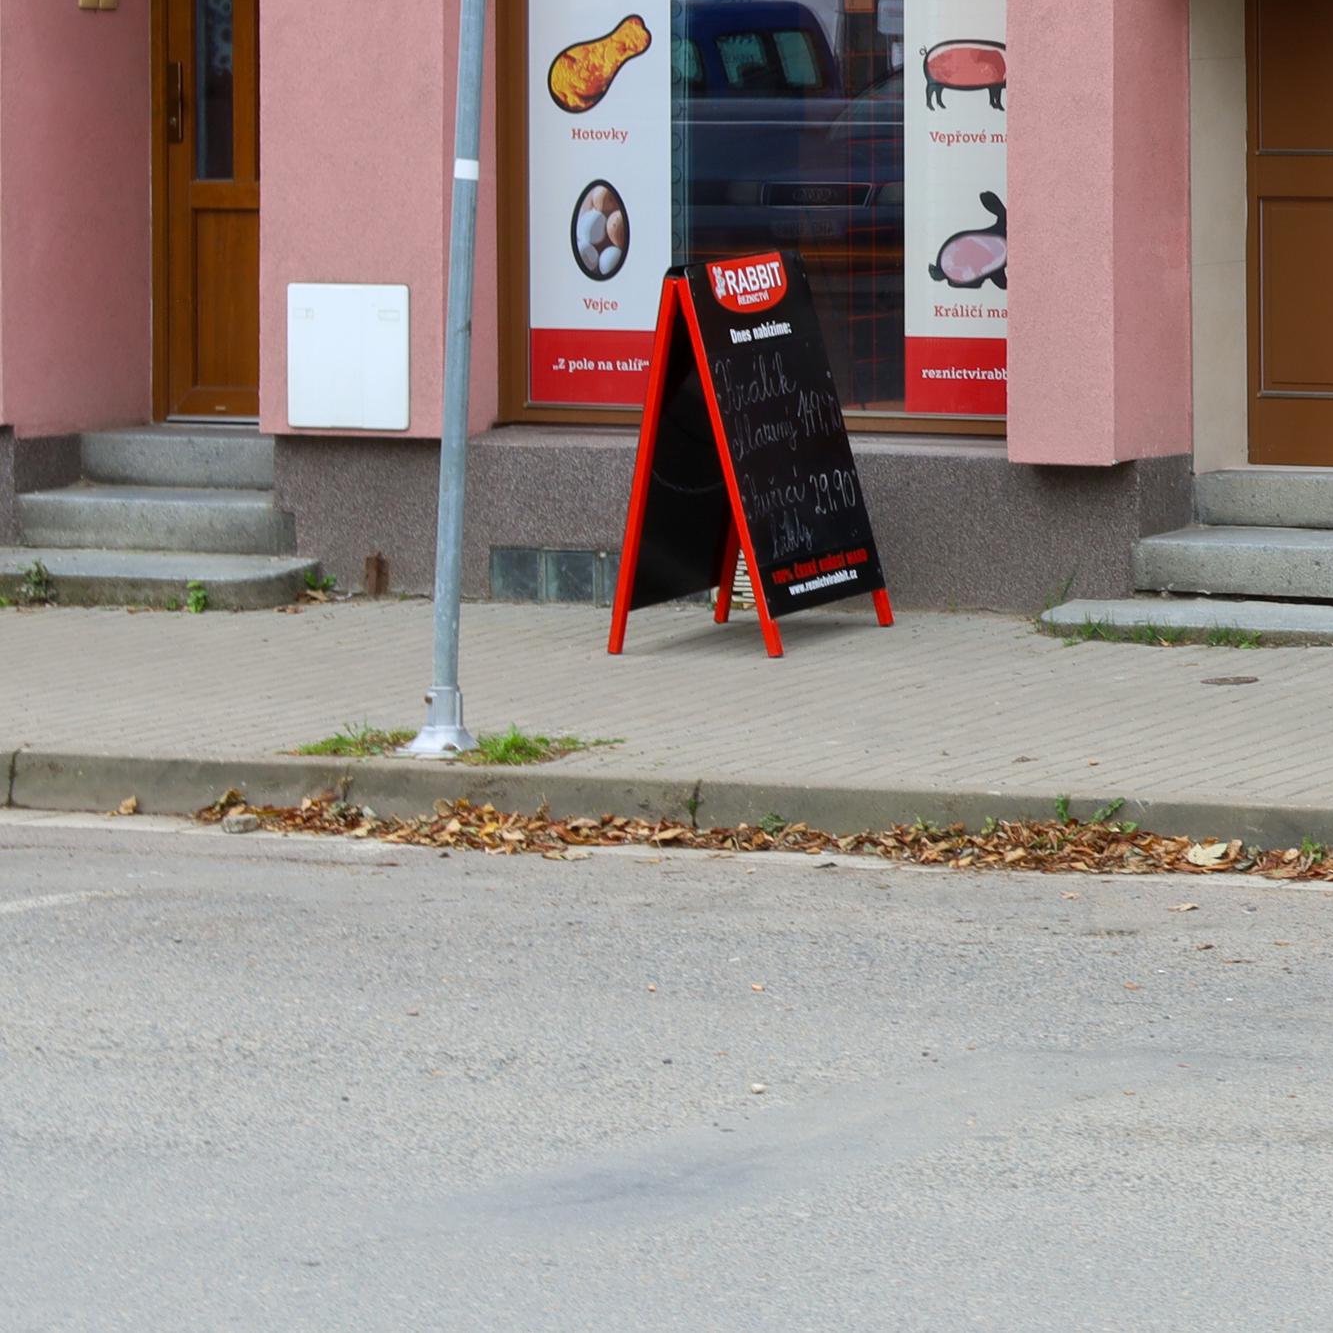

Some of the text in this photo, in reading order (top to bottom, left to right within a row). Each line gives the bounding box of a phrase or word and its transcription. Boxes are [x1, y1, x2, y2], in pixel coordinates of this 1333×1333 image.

[571, 128, 629, 144] Hotovky
[929, 130, 987, 146] Vepřové
[724, 261, 782, 296] RABBIT
[583, 298, 618, 314] Vejce
[934, 305, 983, 318] Králičí
[729, 320, 792, 344] Dnes nabízíme:
[568, 358, 594, 373] pole
[598, 362, 613, 371] na
